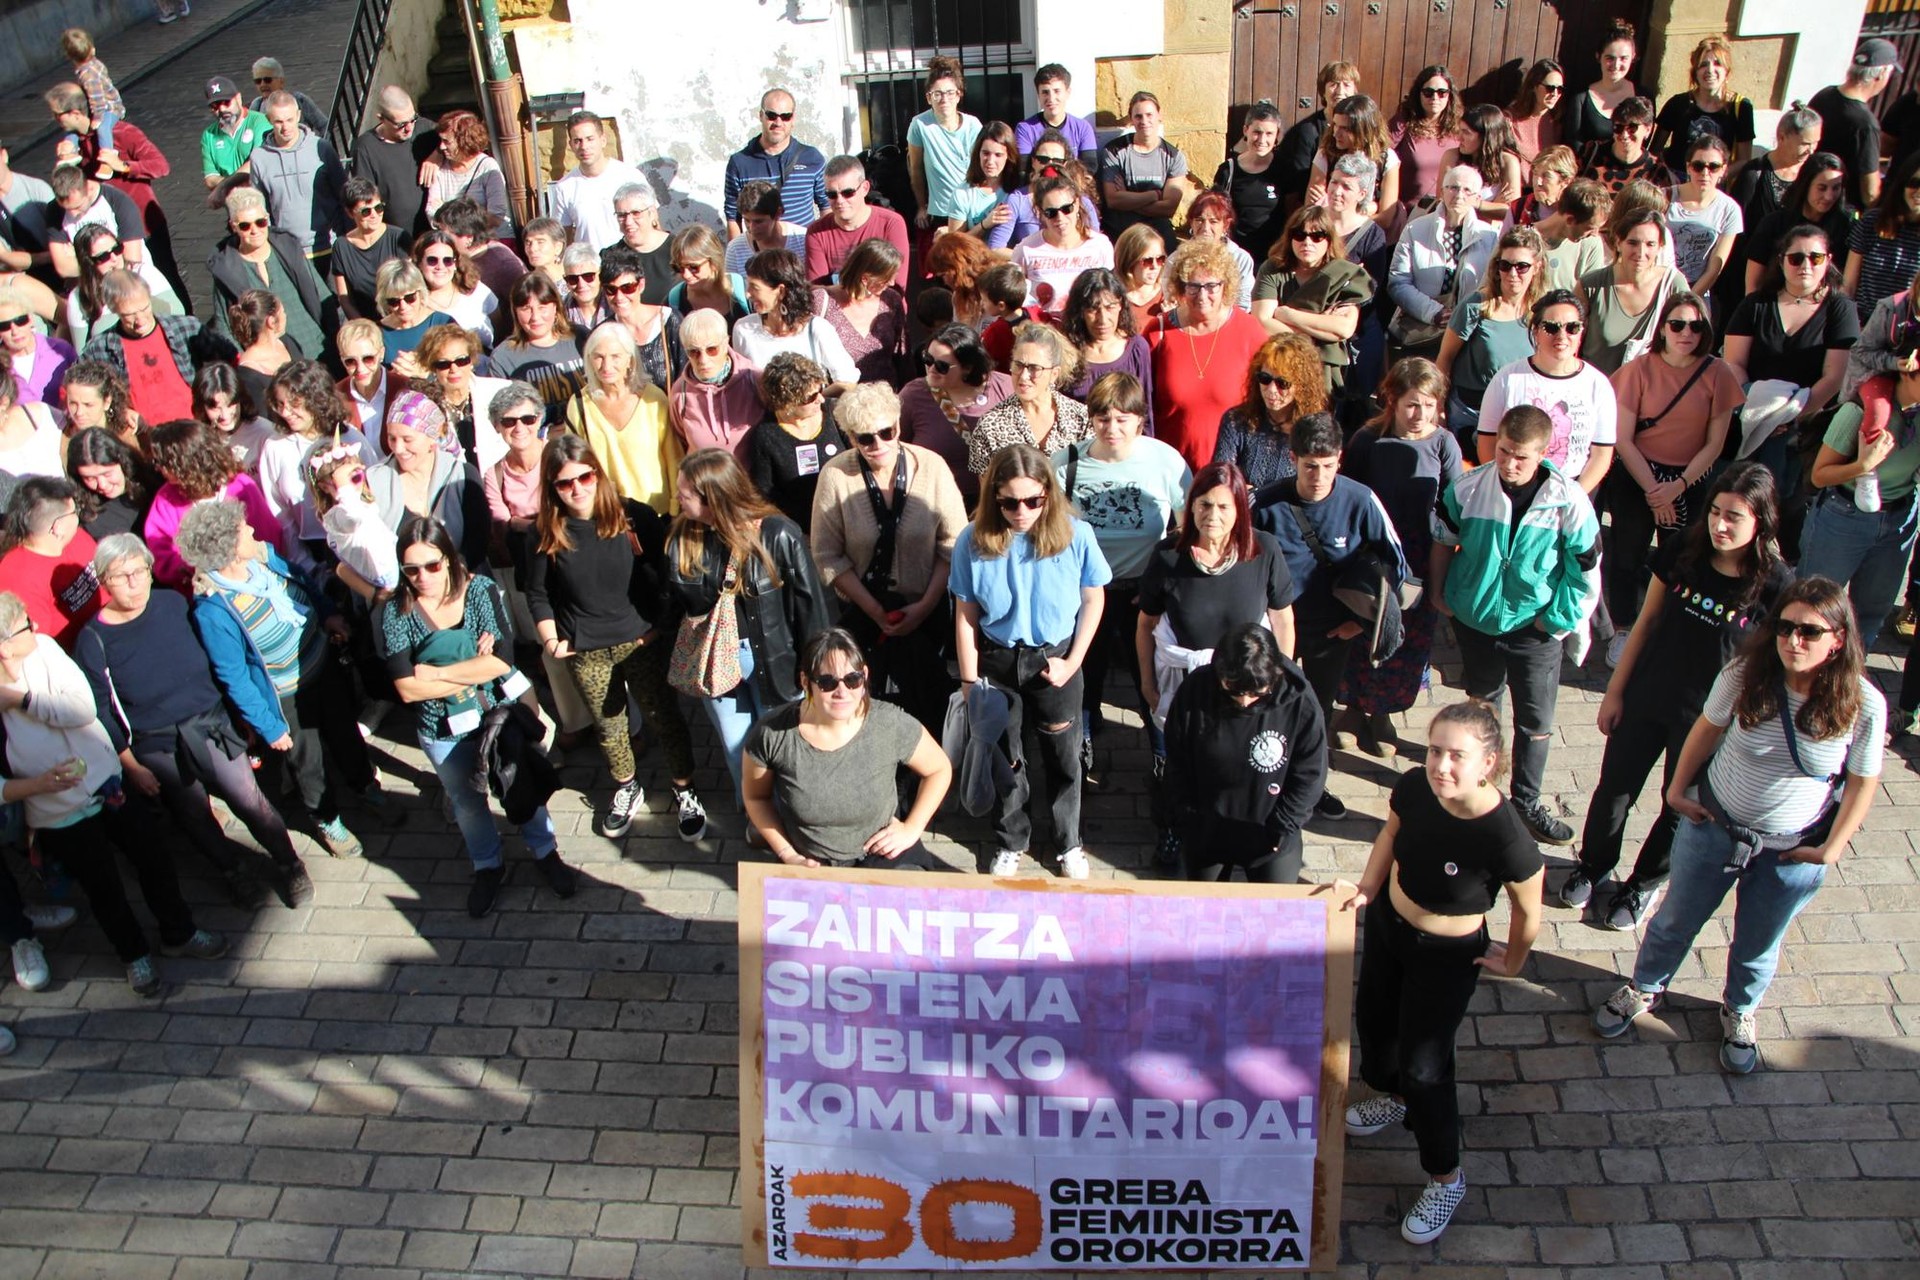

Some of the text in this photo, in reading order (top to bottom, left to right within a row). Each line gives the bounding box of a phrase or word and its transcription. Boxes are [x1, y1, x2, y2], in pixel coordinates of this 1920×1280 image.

[766, 899, 1075, 962] ZAINTZA
[766, 961, 1081, 1023] SISTEMA
[766, 1020, 1066, 1081] PUBLIKO
[766, 1080, 1313, 1141] KOMUNITARIOA!
[770, 1164, 787, 1261] AZAROAK
[788, 1168, 1044, 1263] 30
[1049, 1178, 1211, 1206] GREBA
[1049, 1208, 1301, 1236] FEMINISTA
[1049, 1236, 1305, 1264] OROKORRA
